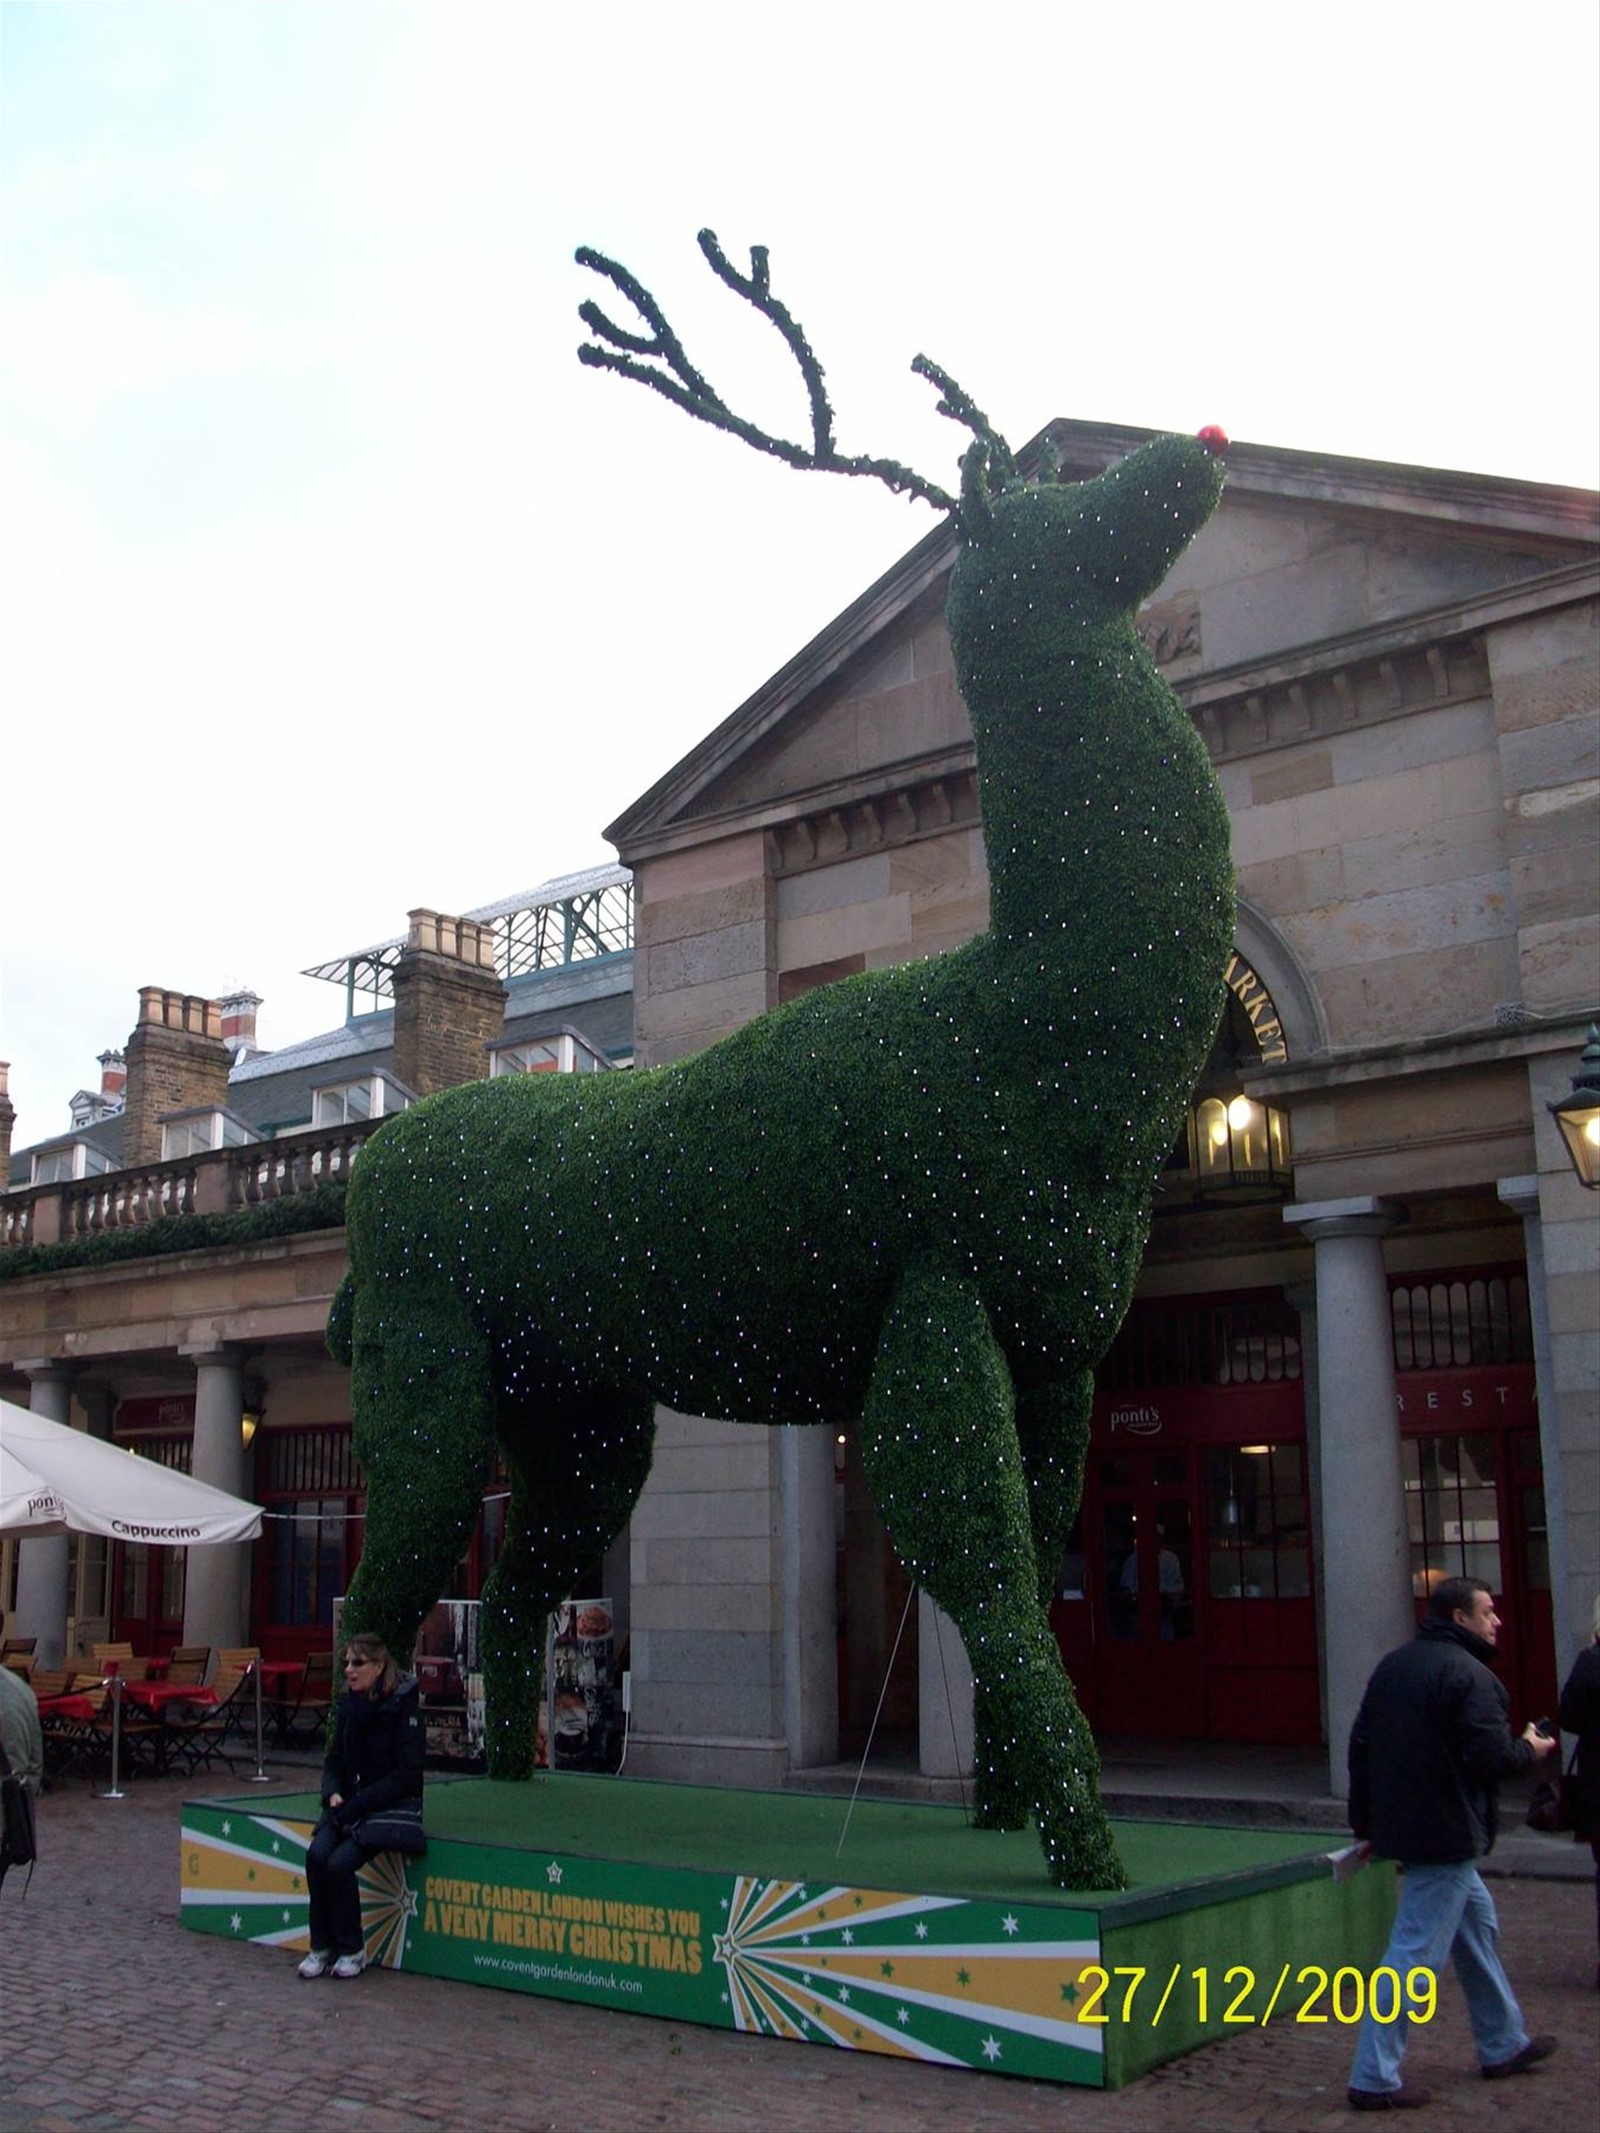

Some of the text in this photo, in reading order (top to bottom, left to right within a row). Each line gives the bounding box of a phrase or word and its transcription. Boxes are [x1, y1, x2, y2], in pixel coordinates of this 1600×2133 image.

[111, 1519, 201, 1539] Cappuccino
[425, 1876, 700, 1937] COVENT GARDEN LONDON WISHES YOU
[423, 1901, 702, 1975] A VERY MERRY CHRISTMAS
[473, 1954, 643, 1993] www.coventgardenlondonuk.com
